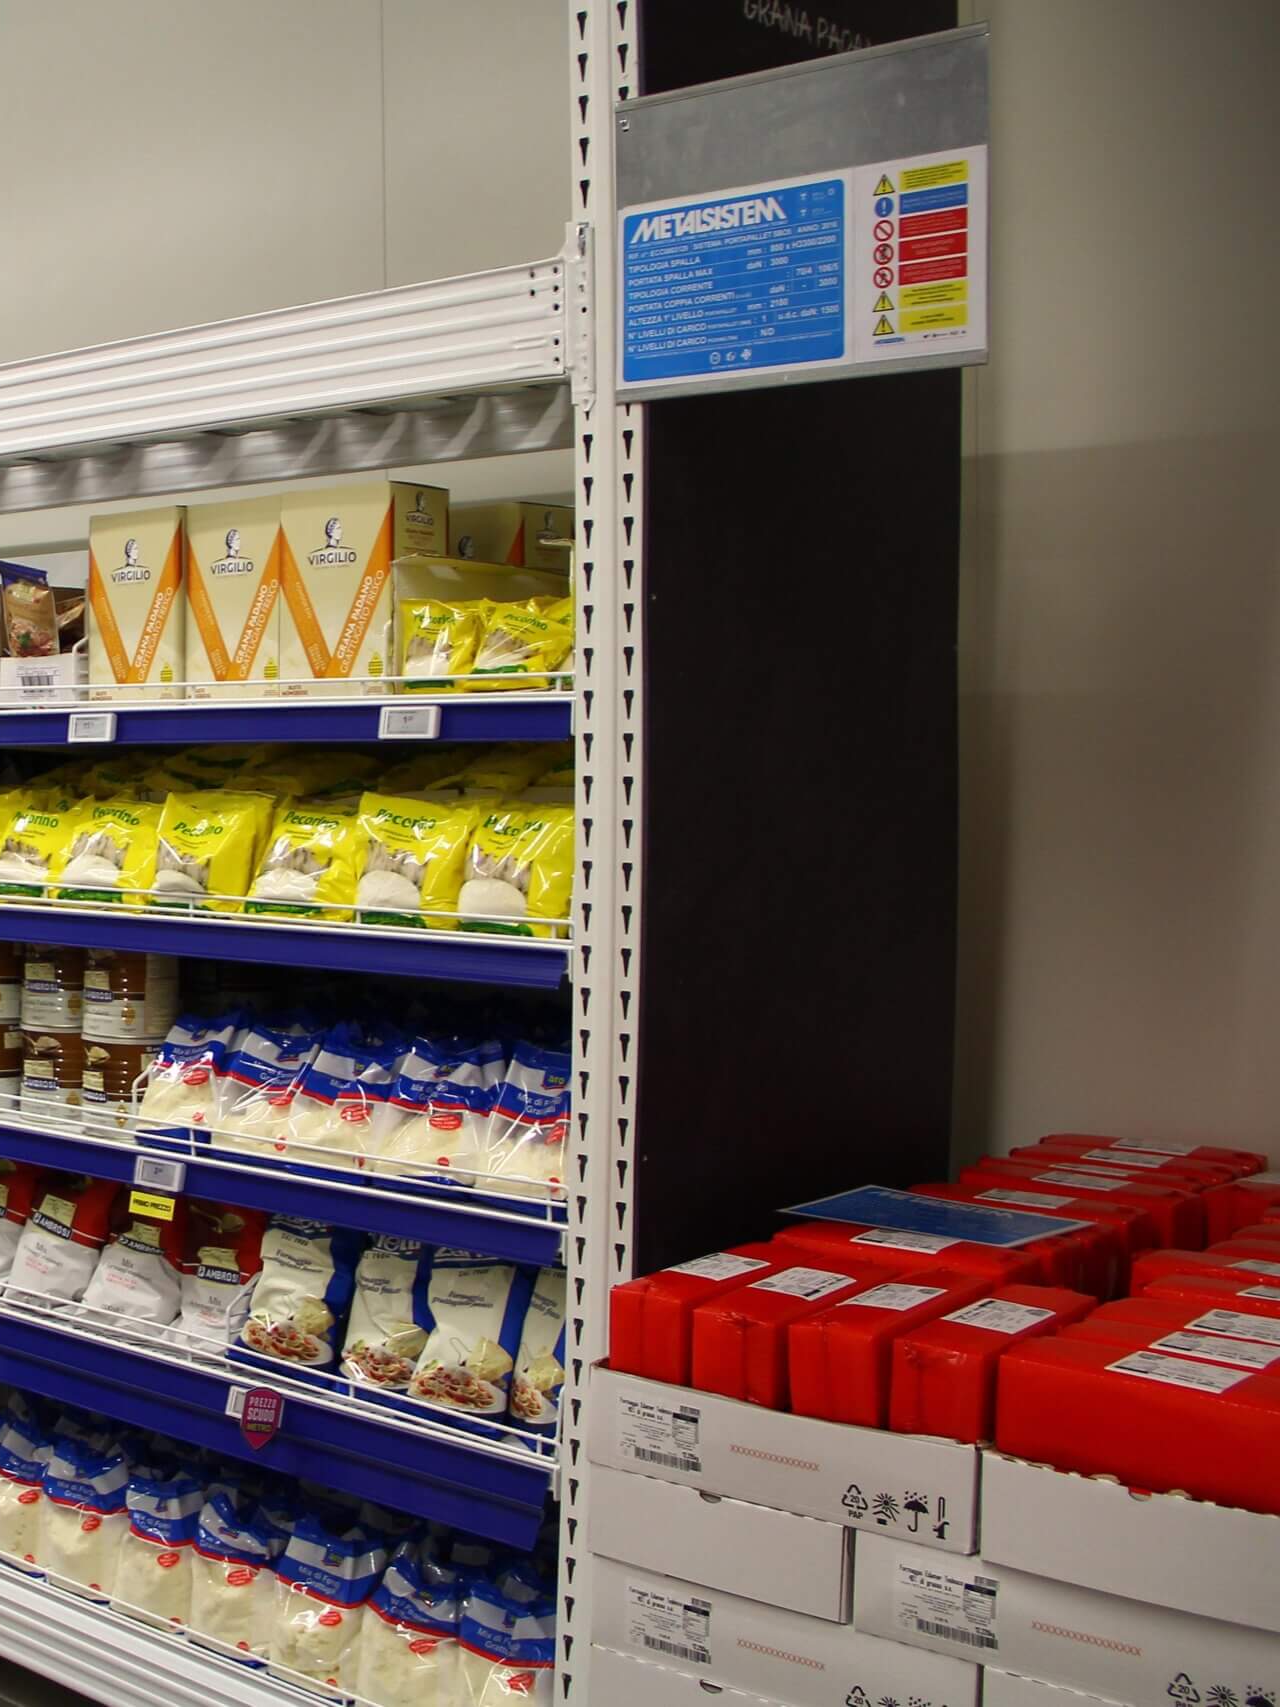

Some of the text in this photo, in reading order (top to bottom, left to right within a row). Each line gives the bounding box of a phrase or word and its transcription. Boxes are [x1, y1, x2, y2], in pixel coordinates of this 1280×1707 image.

[630, 196, 787, 244] METALSISTEM
[307, 551, 357, 566] VIRGILIO
[210, 561, 254, 575] VIRGILIO
[111, 569, 151, 583] VIRGILIO
[236, 584, 268, 664] GRANA PADANO
[337, 575, 373, 659] GRANA PADANO
[135, 592, 164, 668] GRANA PADANO
[39, 1217, 72, 1239] AMBROSI
[248, 1396, 278, 1409] PREZZO
[247, 1407, 276, 1423] SCUDO
[848, 1509, 864, 1520] PAP
[1178, 1684, 1190, 1695] 20
